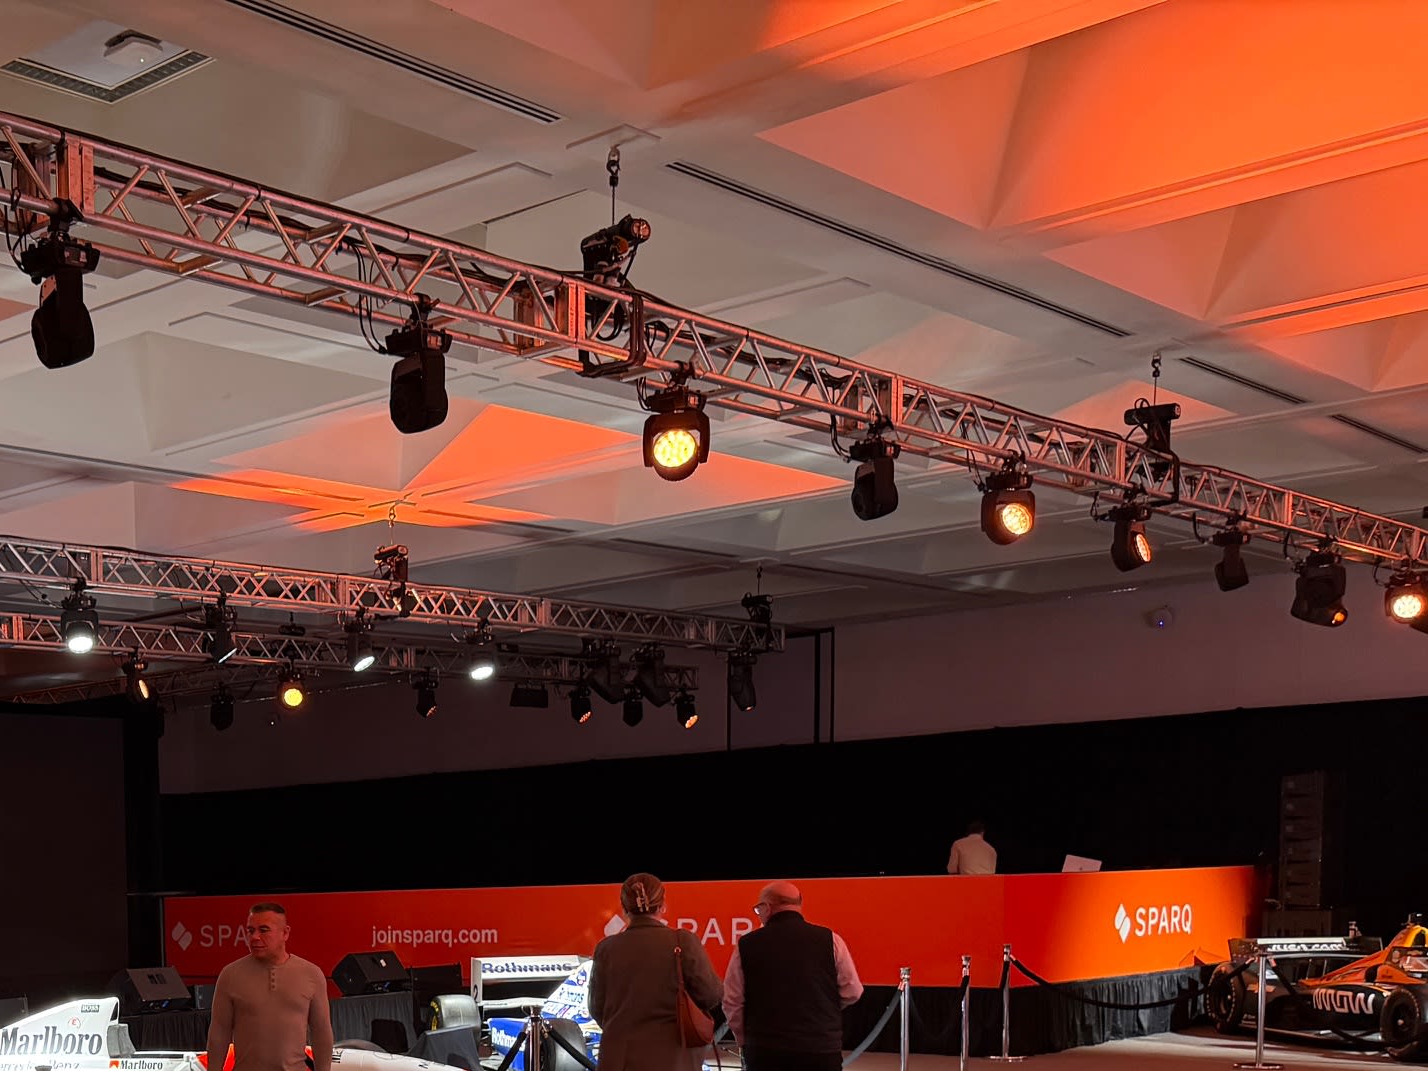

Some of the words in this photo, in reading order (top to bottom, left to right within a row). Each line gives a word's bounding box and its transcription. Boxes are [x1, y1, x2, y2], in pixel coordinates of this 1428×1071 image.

[1134, 903, 1192, 937] SPARQ
[200, 924, 251, 948] SPA
[372, 926, 498, 947] joinsparq.com
[482, 962, 573, 974] Rothmans
[121, 1060, 164, 1070] Marlboro
